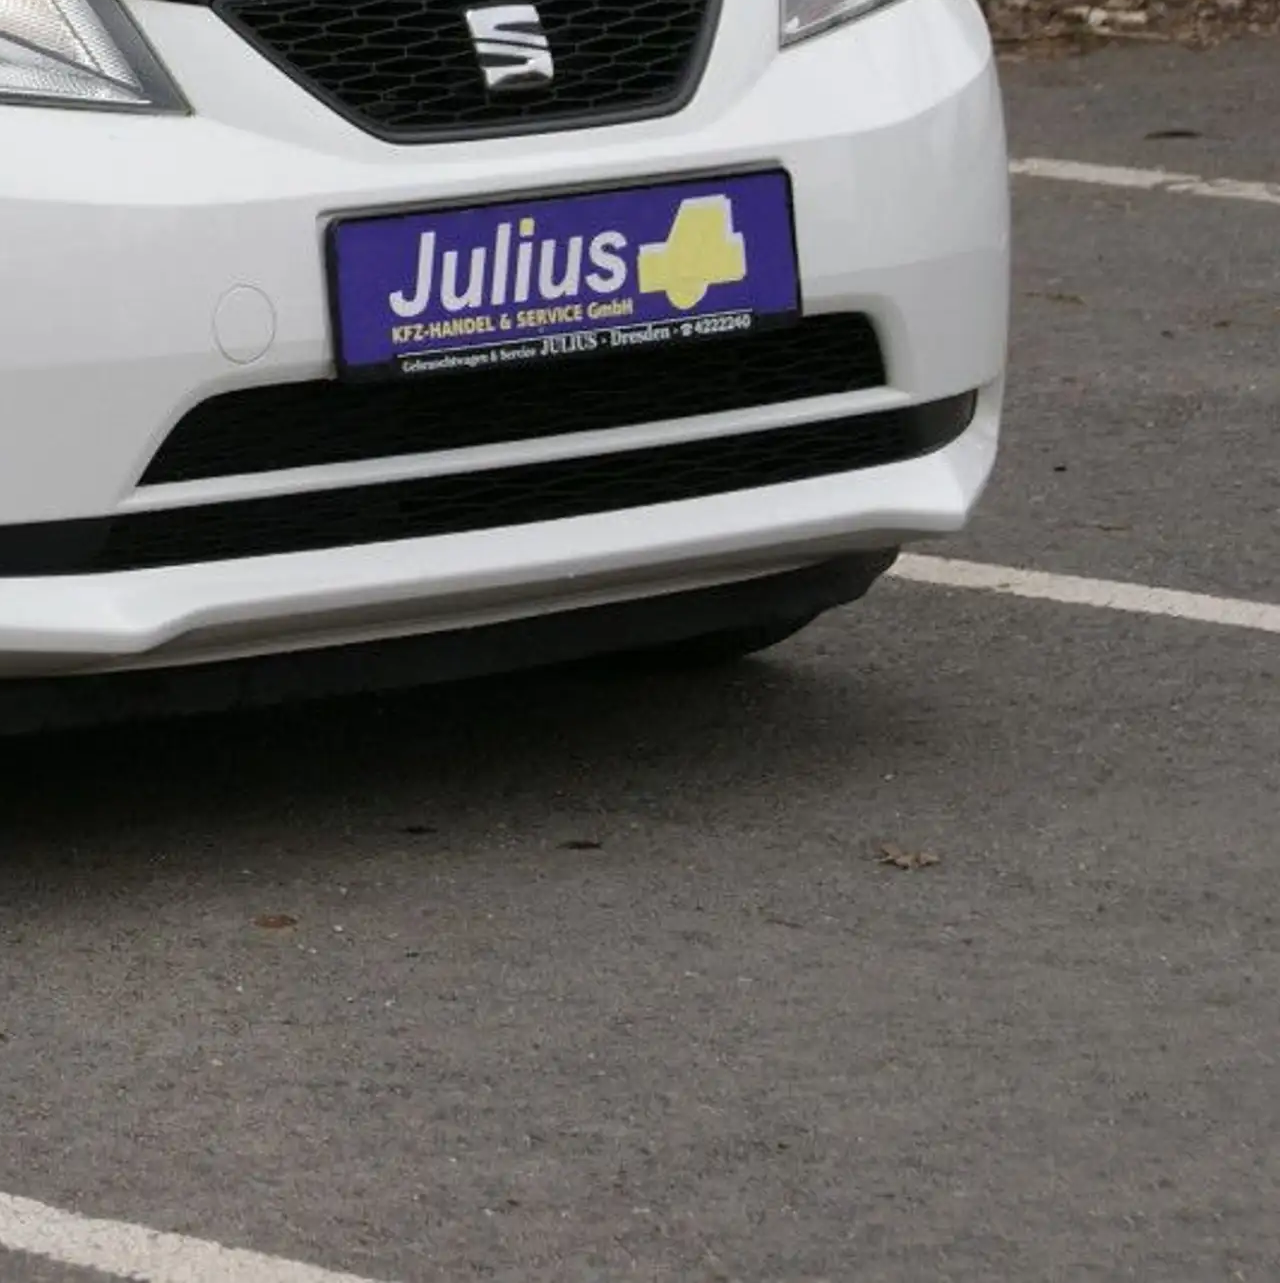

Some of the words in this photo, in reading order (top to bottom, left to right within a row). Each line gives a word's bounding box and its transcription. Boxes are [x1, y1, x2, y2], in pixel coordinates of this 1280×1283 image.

[389, 217, 627, 318] Julius
[392, 315, 496, 344] KFZ-HANDEL
[499, 313, 512, 330] &
[516, 304, 583, 328] SERVICE
[589, 298, 634, 319] GmbH
[540, 332, 597, 356] JULIUS
[610, 324, 670, 347] Dresden
